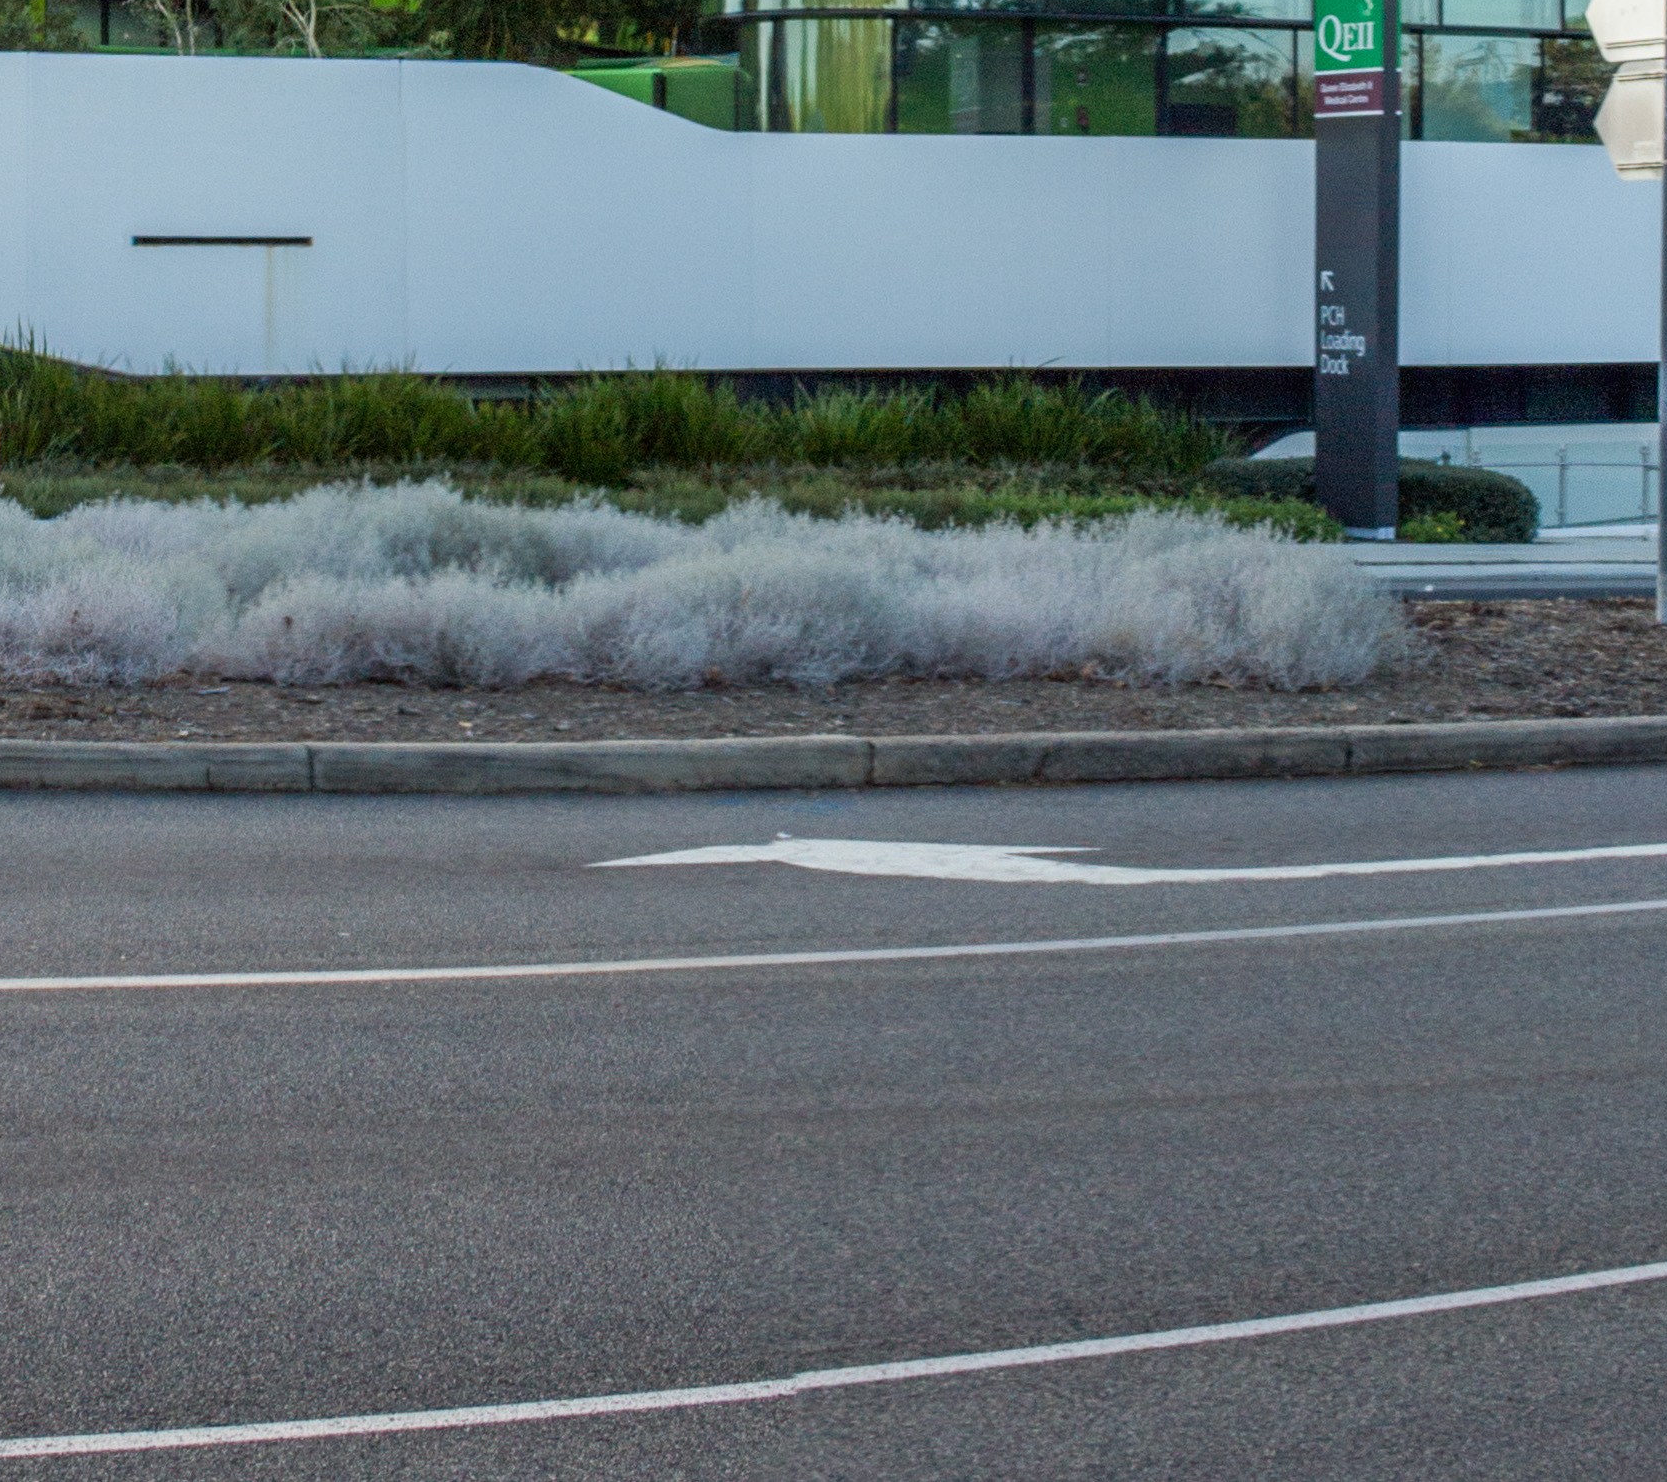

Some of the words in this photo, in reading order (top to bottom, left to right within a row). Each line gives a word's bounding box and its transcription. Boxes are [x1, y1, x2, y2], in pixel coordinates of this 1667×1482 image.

[1318, 14, 1375, 62] QEII
[1320, 305, 1345, 326] PCH
[1320, 329, 1366, 357] Loading
[1320, 353, 1350, 375] Dock
